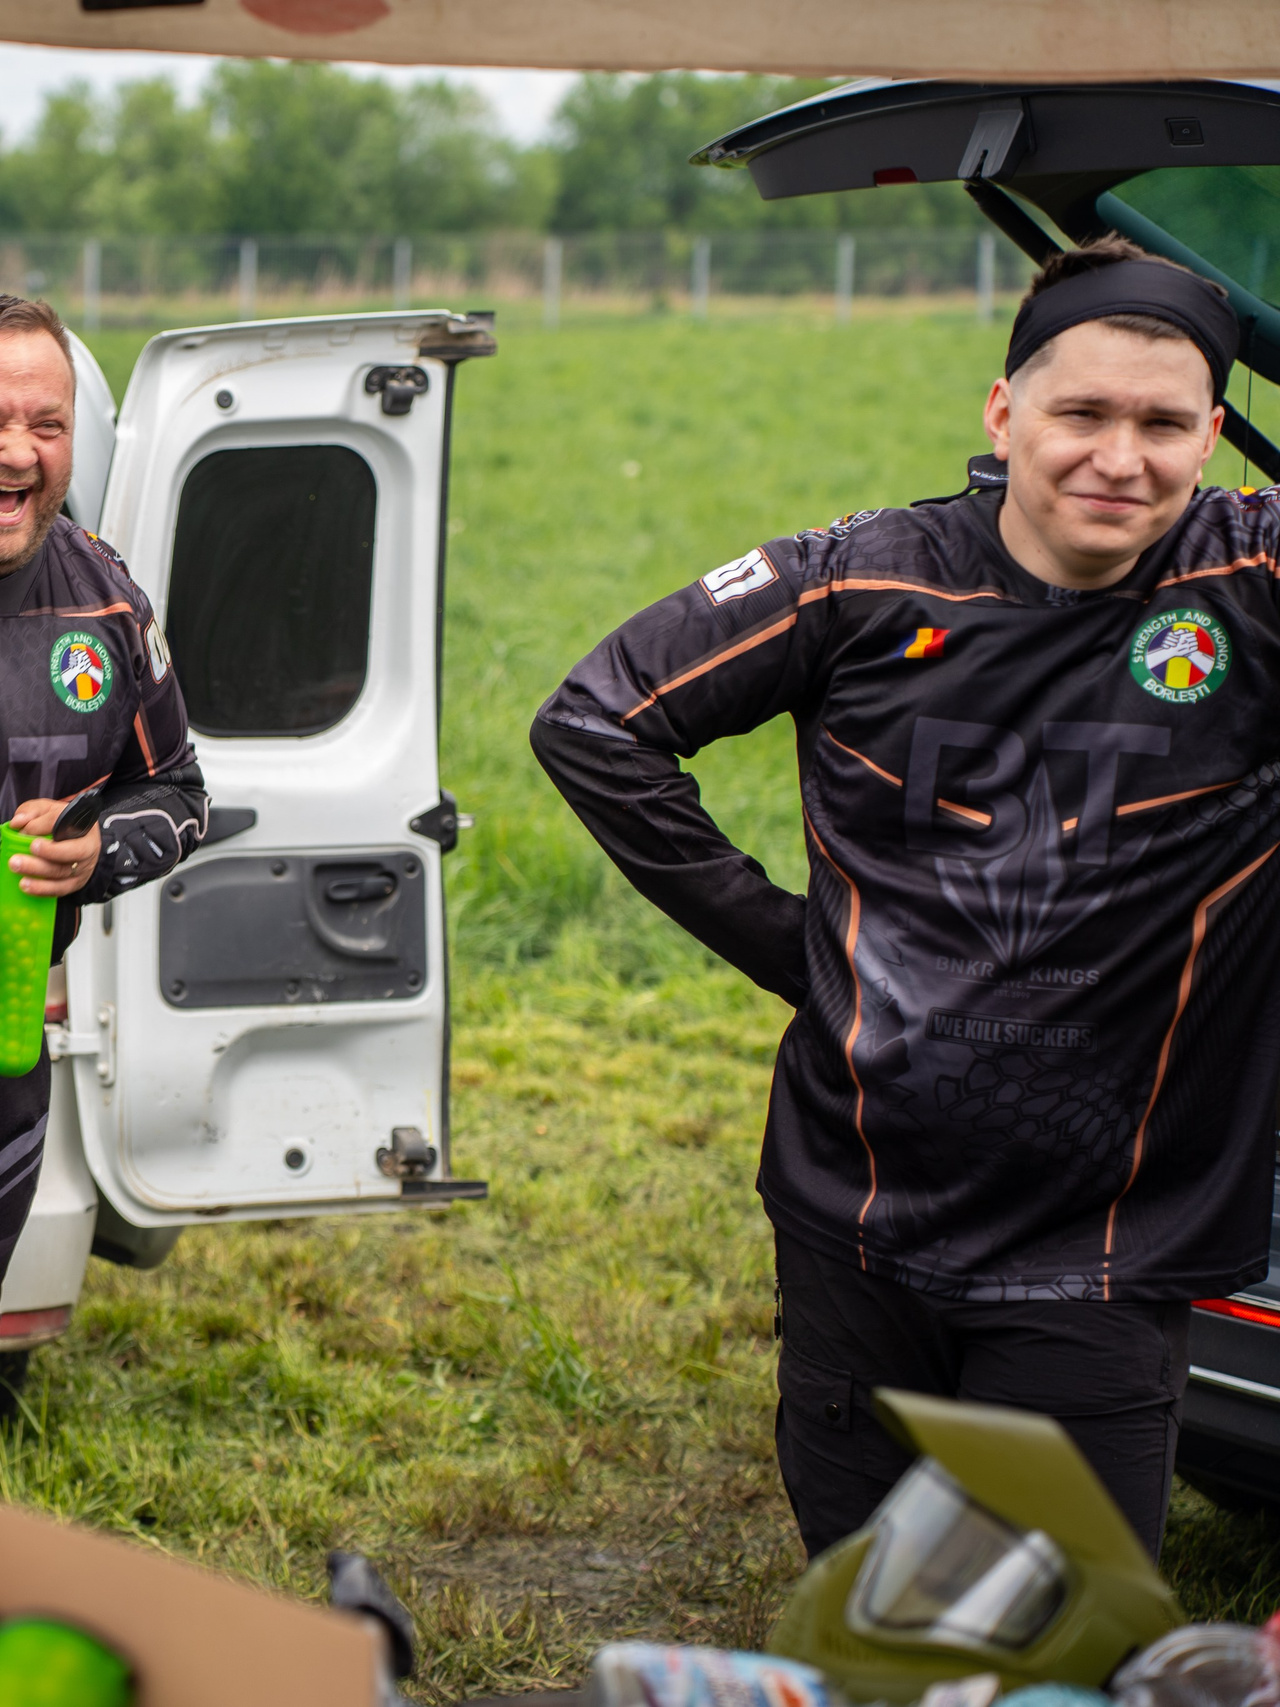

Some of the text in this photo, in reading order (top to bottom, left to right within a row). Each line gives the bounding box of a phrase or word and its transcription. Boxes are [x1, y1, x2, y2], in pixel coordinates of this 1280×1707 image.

[51, 634, 112, 683] STRENGTH AND HONOR
[1132, 611, 1228, 671] STRENGTH AND HONOR
[906, 716, 1172, 864] BT
[936, 956, 1100, 985] BNKR KINGS
[1004, 1023, 1093, 1048] SUCKERS
